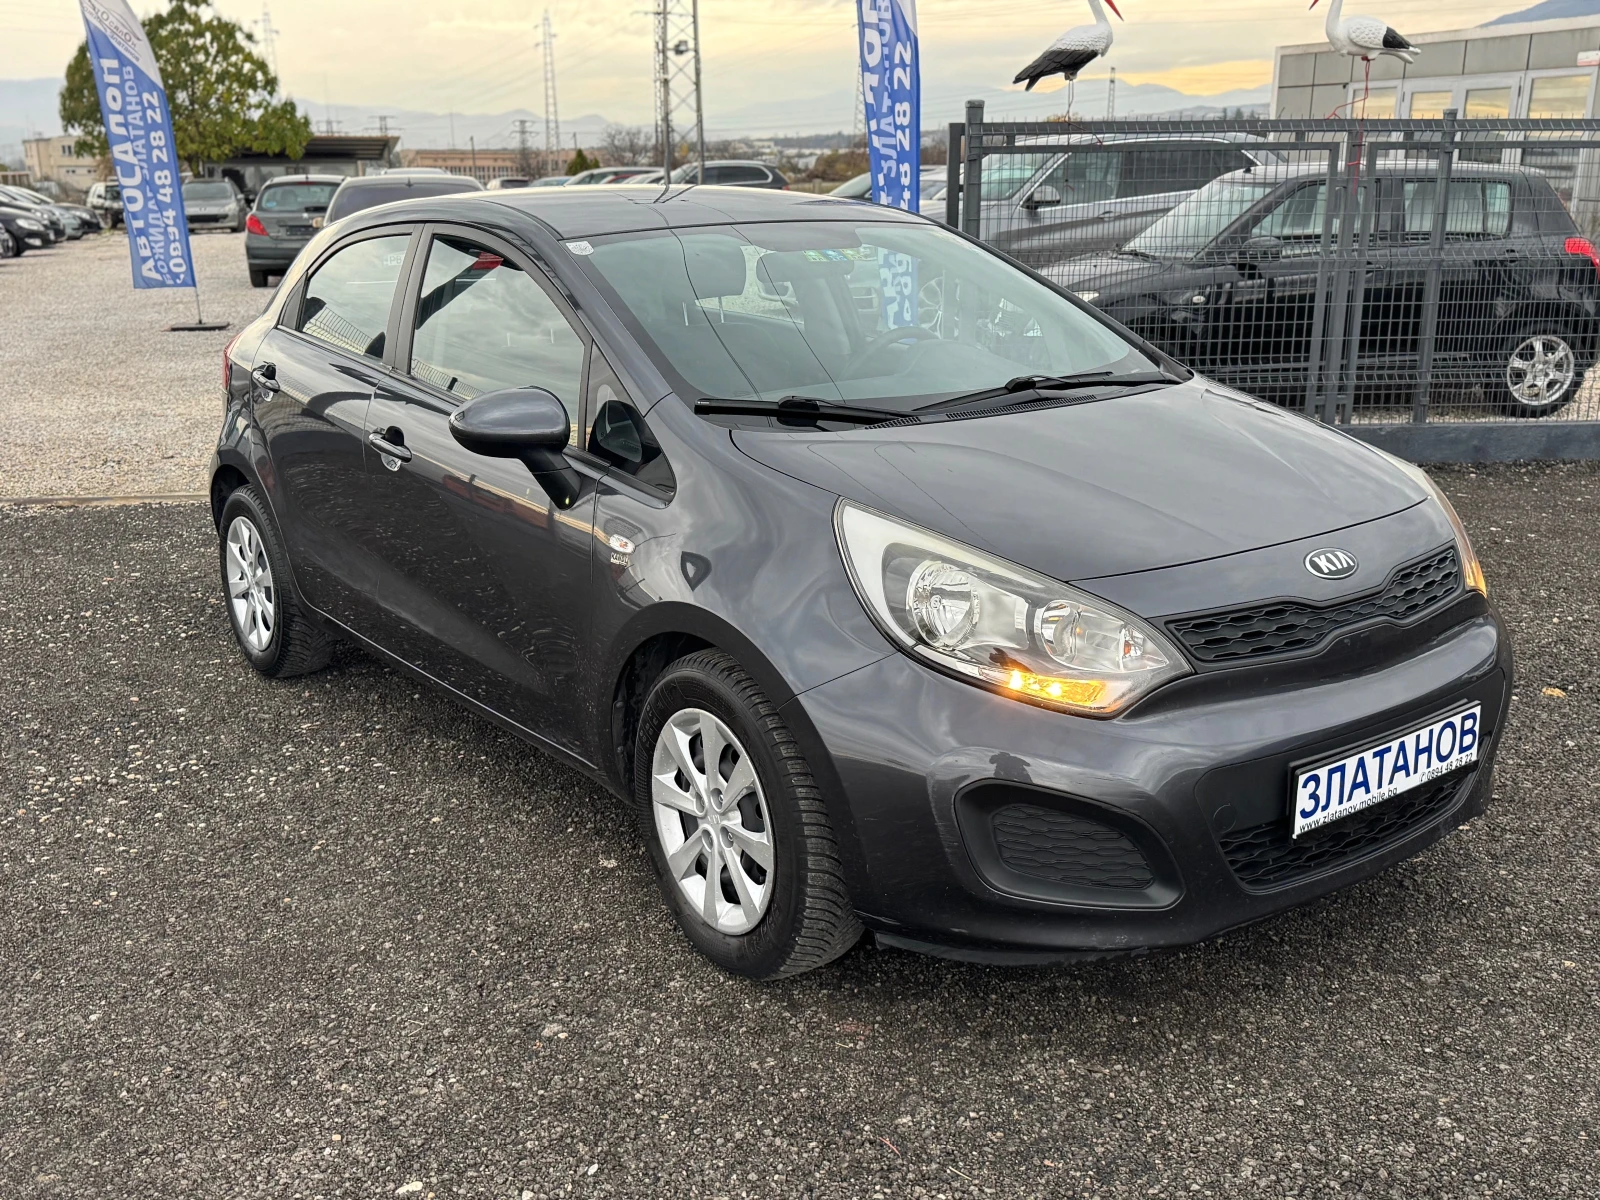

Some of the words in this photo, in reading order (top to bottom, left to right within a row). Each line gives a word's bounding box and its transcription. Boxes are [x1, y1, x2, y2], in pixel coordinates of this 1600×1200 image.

[894, 41, 911, 91] 22
[142, 91, 162, 124] 22
[894, 101, 911, 151] 28
[149, 130, 168, 163] 28
[154, 169, 173, 204] 48
[163, 208, 186, 273] 0894
[1312, 551, 1355, 574] KIA
[1299, 711, 1478, 820] ЗЛАТАНОВ
[1426, 765, 1443, 781] 0894
[1444, 762, 1454, 773] 48
[1454, 758, 1464, 769] 28
[1464, 752, 1474, 765] 22
[1299, 786, 1398, 833] www.zlatanov.mobile.bg
